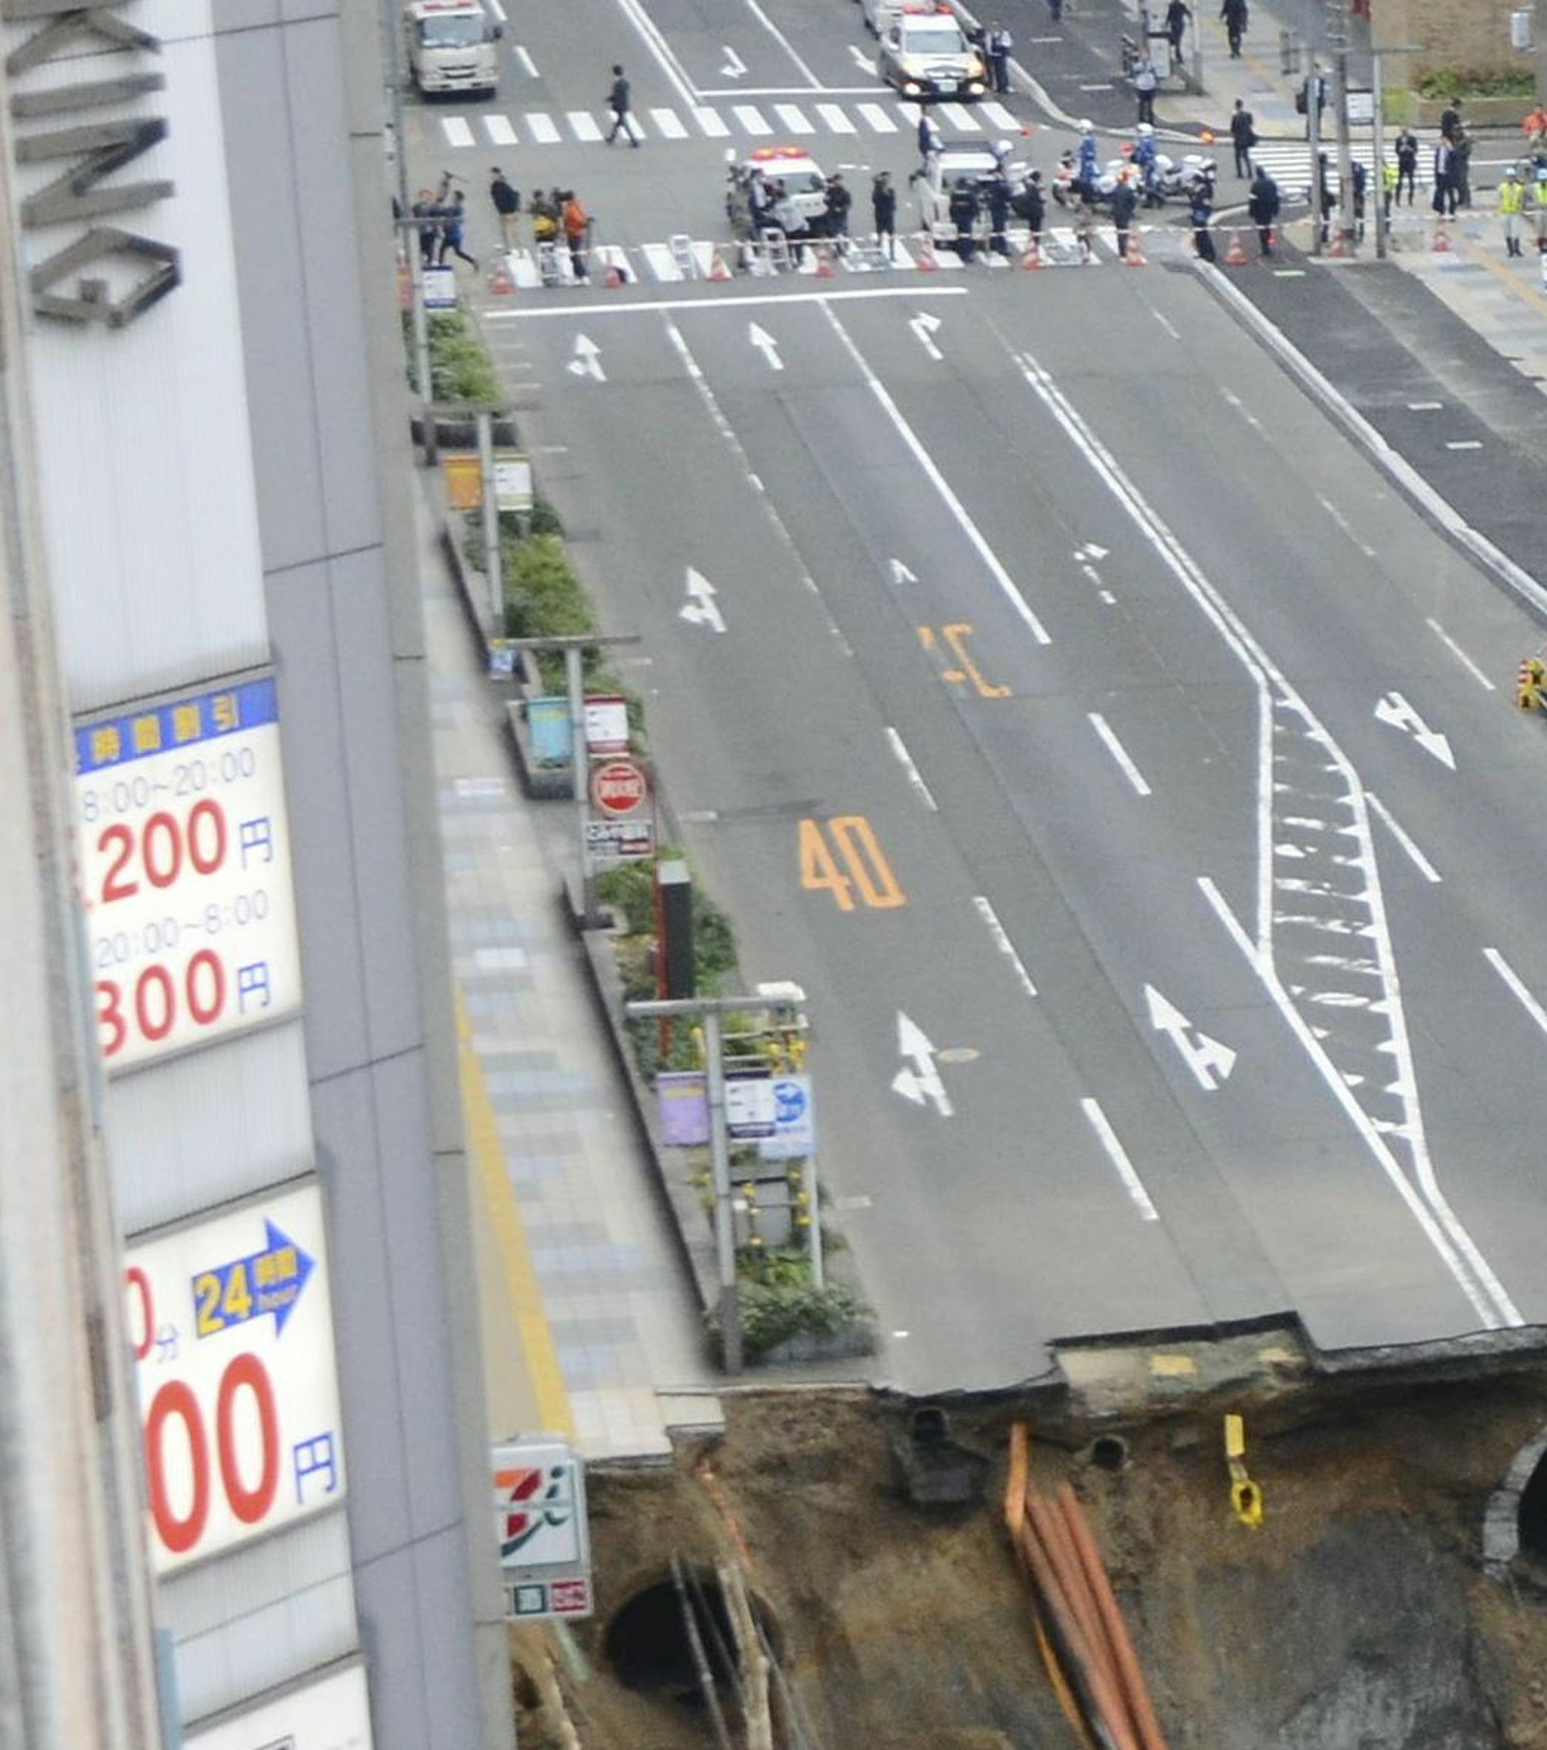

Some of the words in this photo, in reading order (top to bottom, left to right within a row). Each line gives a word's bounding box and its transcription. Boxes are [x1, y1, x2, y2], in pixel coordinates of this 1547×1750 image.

[83, 797, 274, 912] 200円
[797, 814, 909, 912] 40
[193, 1262, 252, 1337] 24
